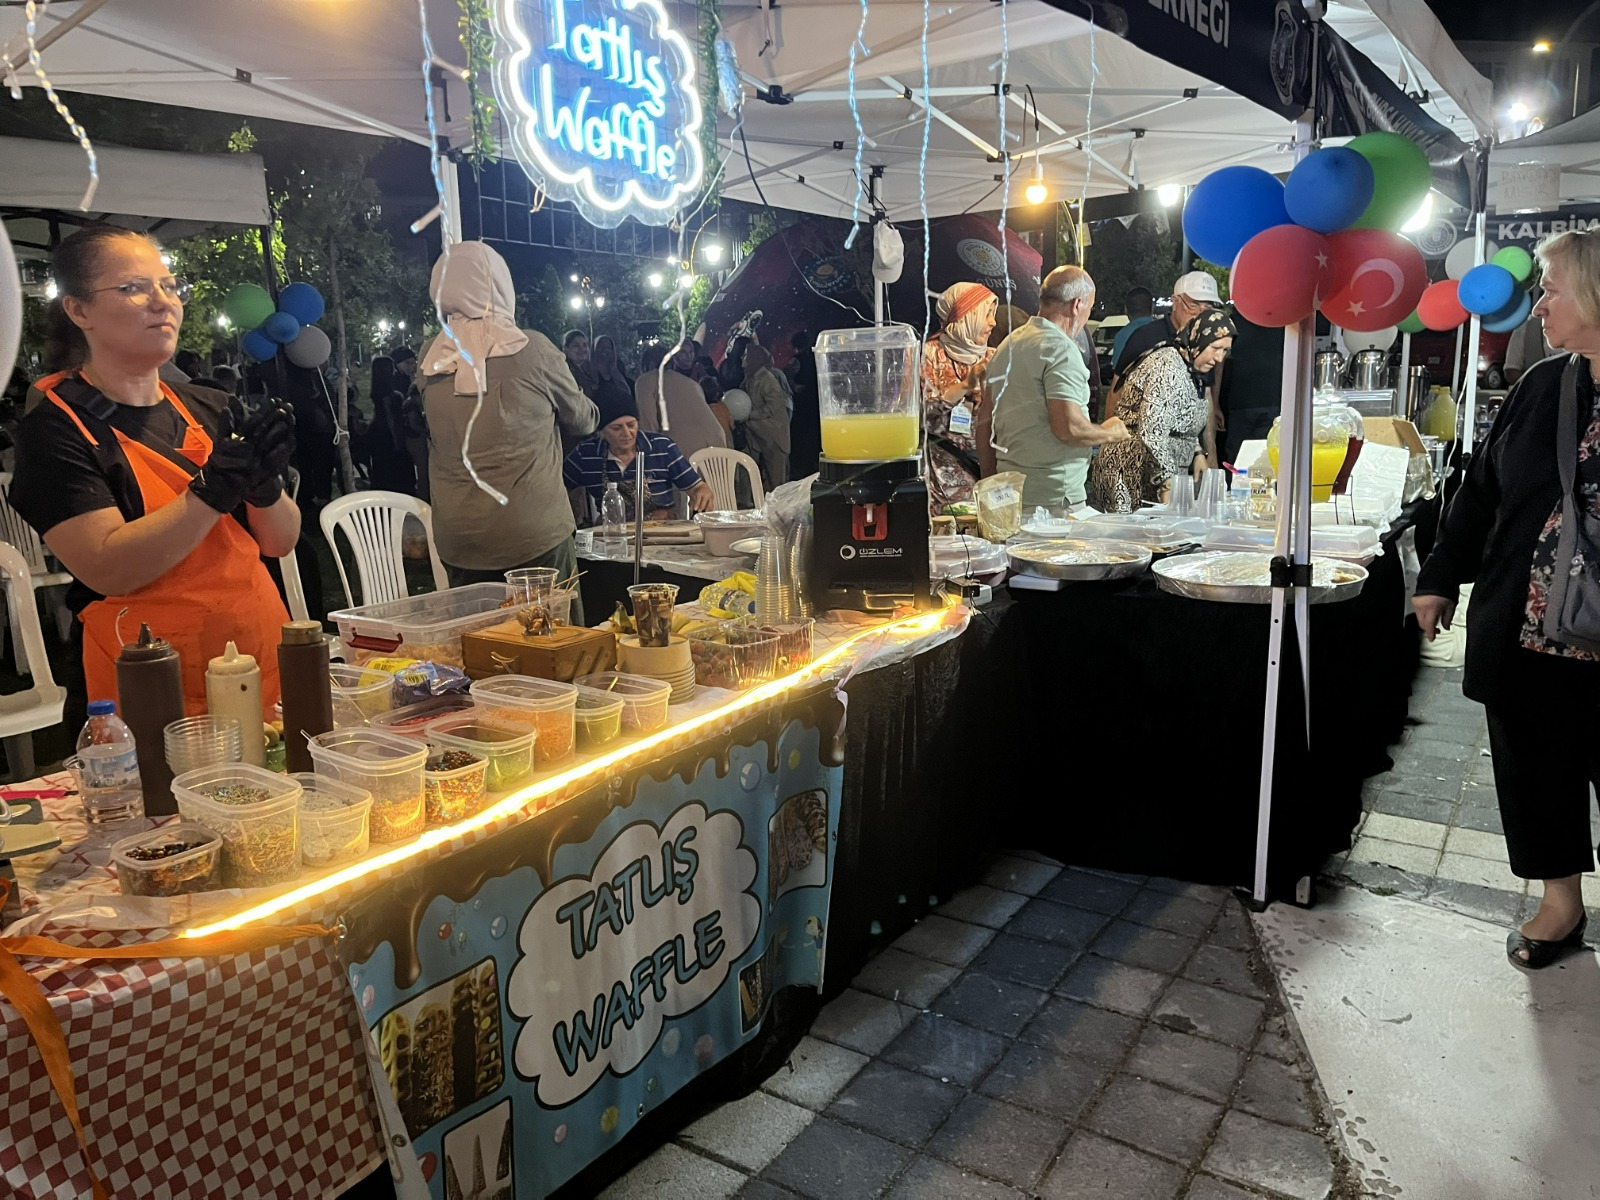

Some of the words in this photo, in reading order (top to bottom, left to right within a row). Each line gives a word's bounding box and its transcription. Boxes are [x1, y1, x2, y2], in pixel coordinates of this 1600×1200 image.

[541, 63, 677, 181] Waffle
[557, 825, 701, 959] TATLIŞ
[552, 910, 726, 1077] WAFFLE
